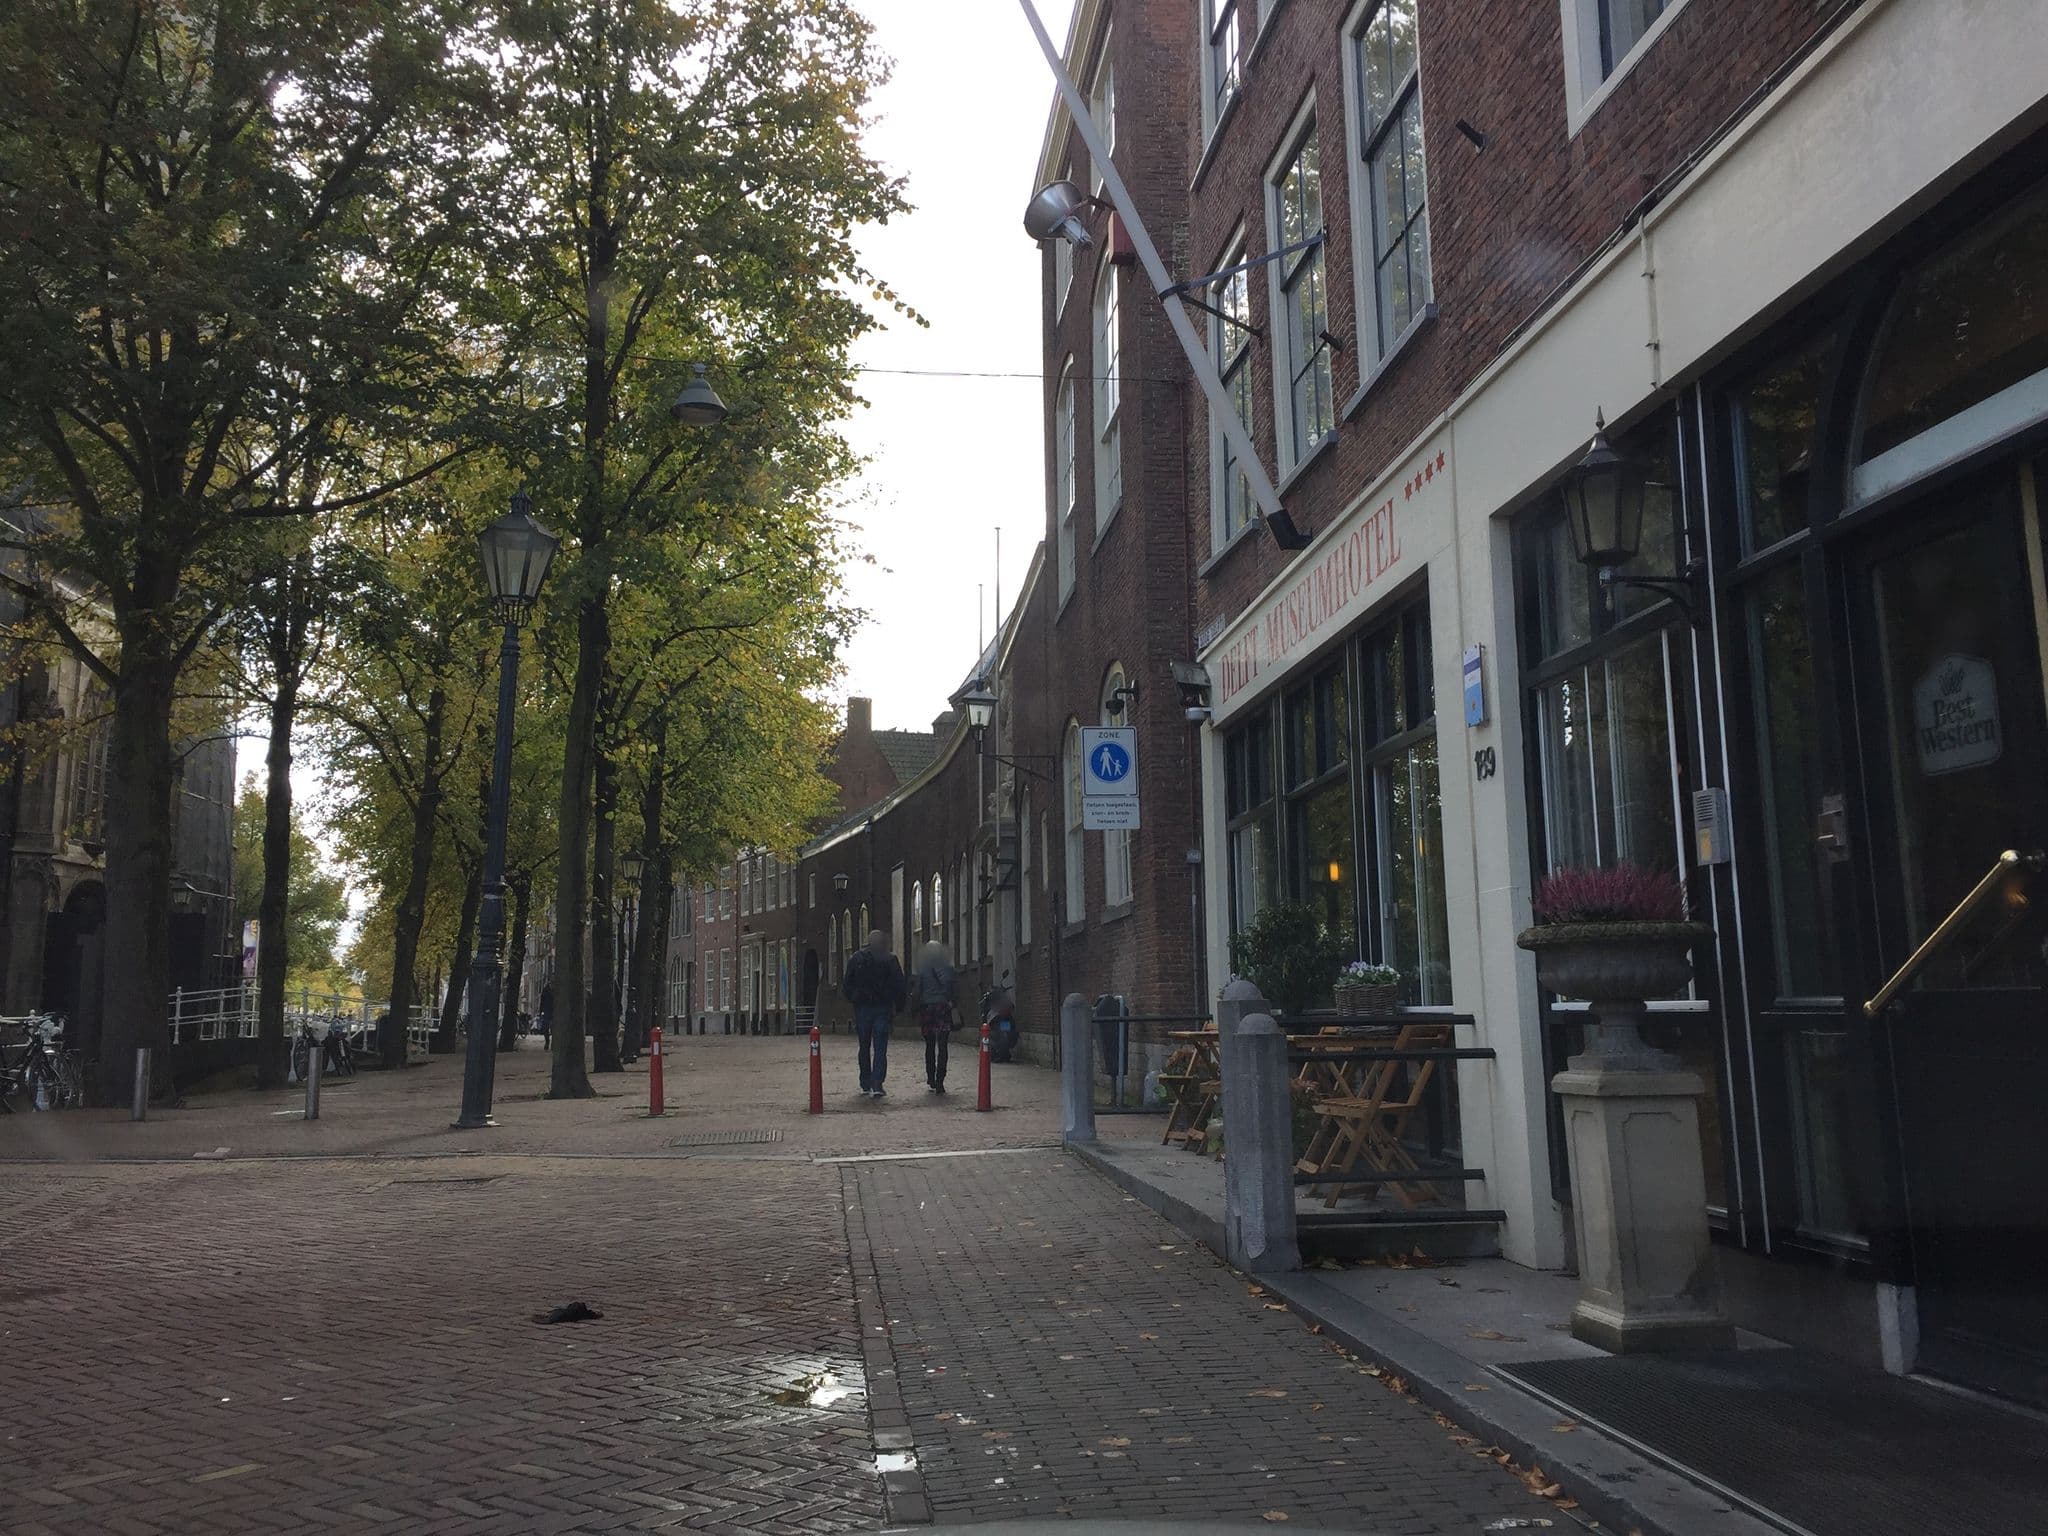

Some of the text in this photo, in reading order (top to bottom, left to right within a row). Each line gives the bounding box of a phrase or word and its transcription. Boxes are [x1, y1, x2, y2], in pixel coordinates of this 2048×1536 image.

[1220, 497, 1402, 704] DELFT MUSEUMHOTEL
[1933, 692, 1976, 729] Best
[1098, 731, 1120, 739] ZONE
[1920, 719, 1996, 755] Western
[1474, 746, 1496, 781] 189
